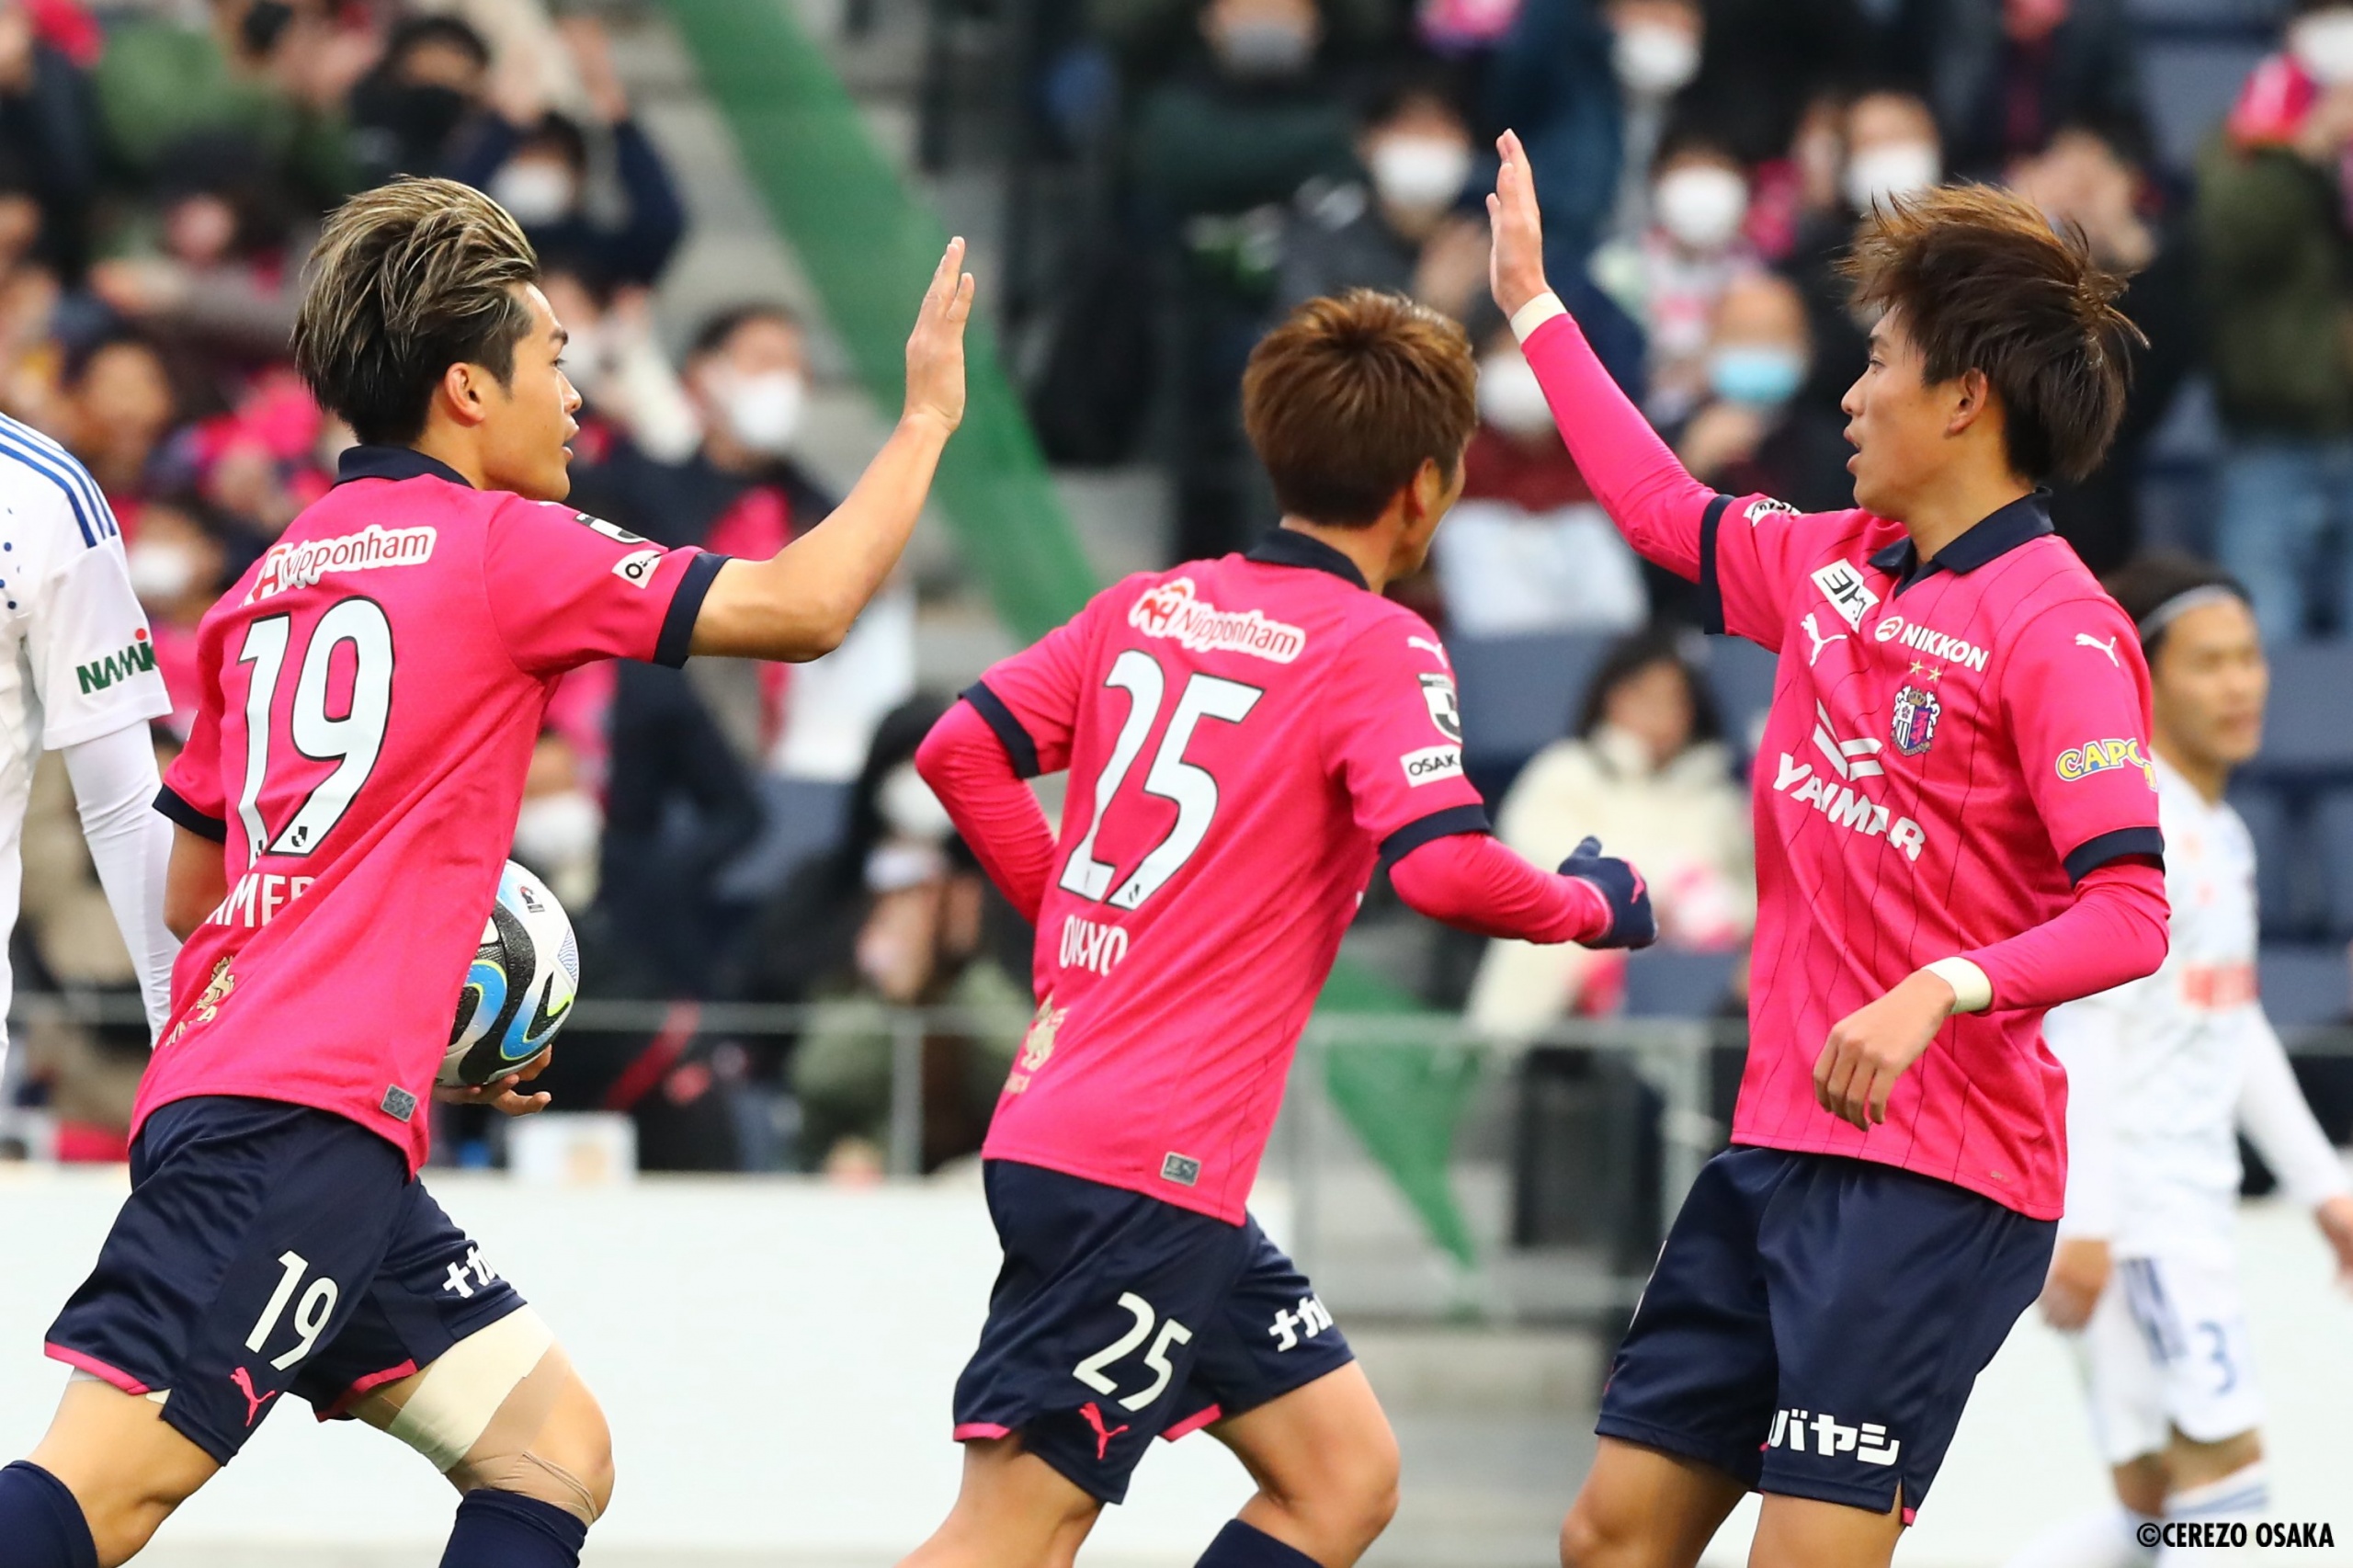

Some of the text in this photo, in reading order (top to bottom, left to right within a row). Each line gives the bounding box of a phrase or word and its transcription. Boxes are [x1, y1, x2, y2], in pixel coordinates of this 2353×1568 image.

[283, 531, 429, 583] Nipponham
[1174, 607, 1298, 655] Nipponham
[1899, 623, 1990, 672] NIKKON
[238, 594, 395, 870] 19
[1058, 649, 1266, 912] 25
[1408, 754, 1461, 777] OSAK
[245, 1248, 340, 1372] 19
[1073, 1291, 1193, 1413] 25
[1768, 1408, 1901, 1467] バヤシ
